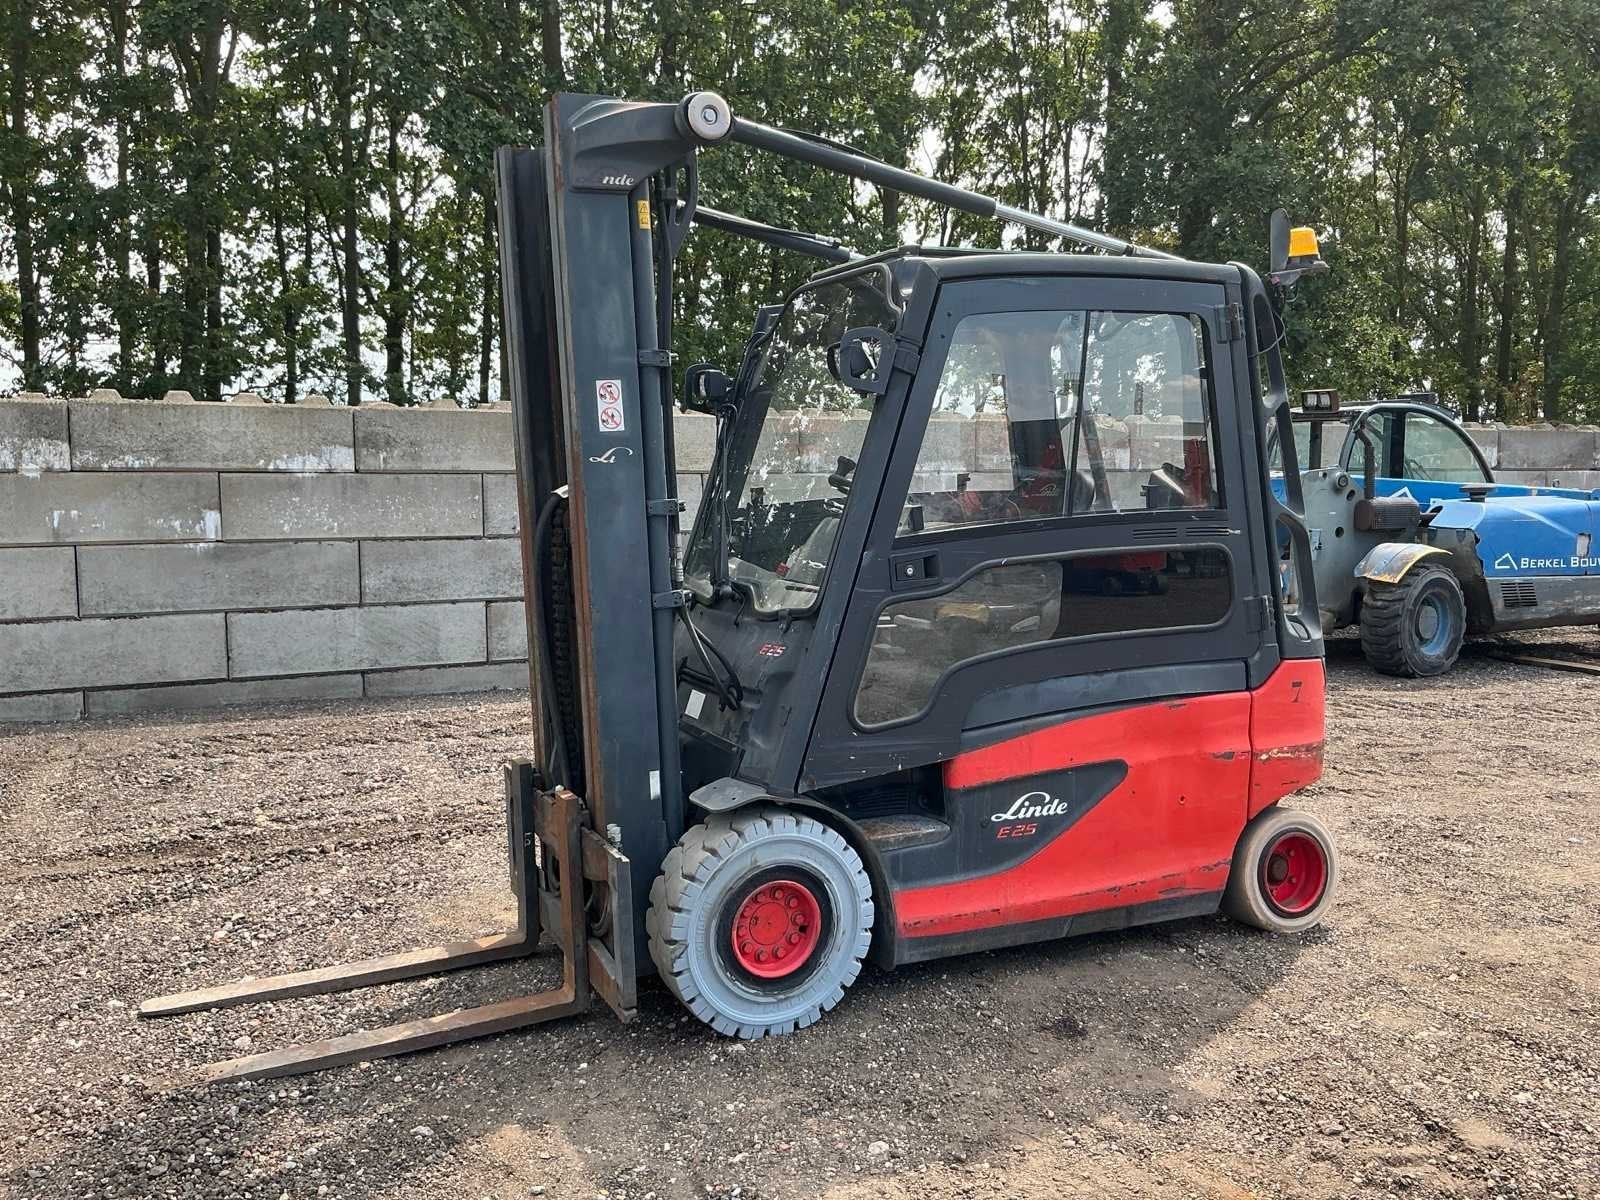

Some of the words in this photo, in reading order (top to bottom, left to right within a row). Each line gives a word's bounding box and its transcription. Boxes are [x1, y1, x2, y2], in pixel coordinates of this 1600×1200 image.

[1520, 557, 1566, 569] BERKEL
[1291, 681, 1303, 703] 7
[991, 791, 1068, 822] Linde
